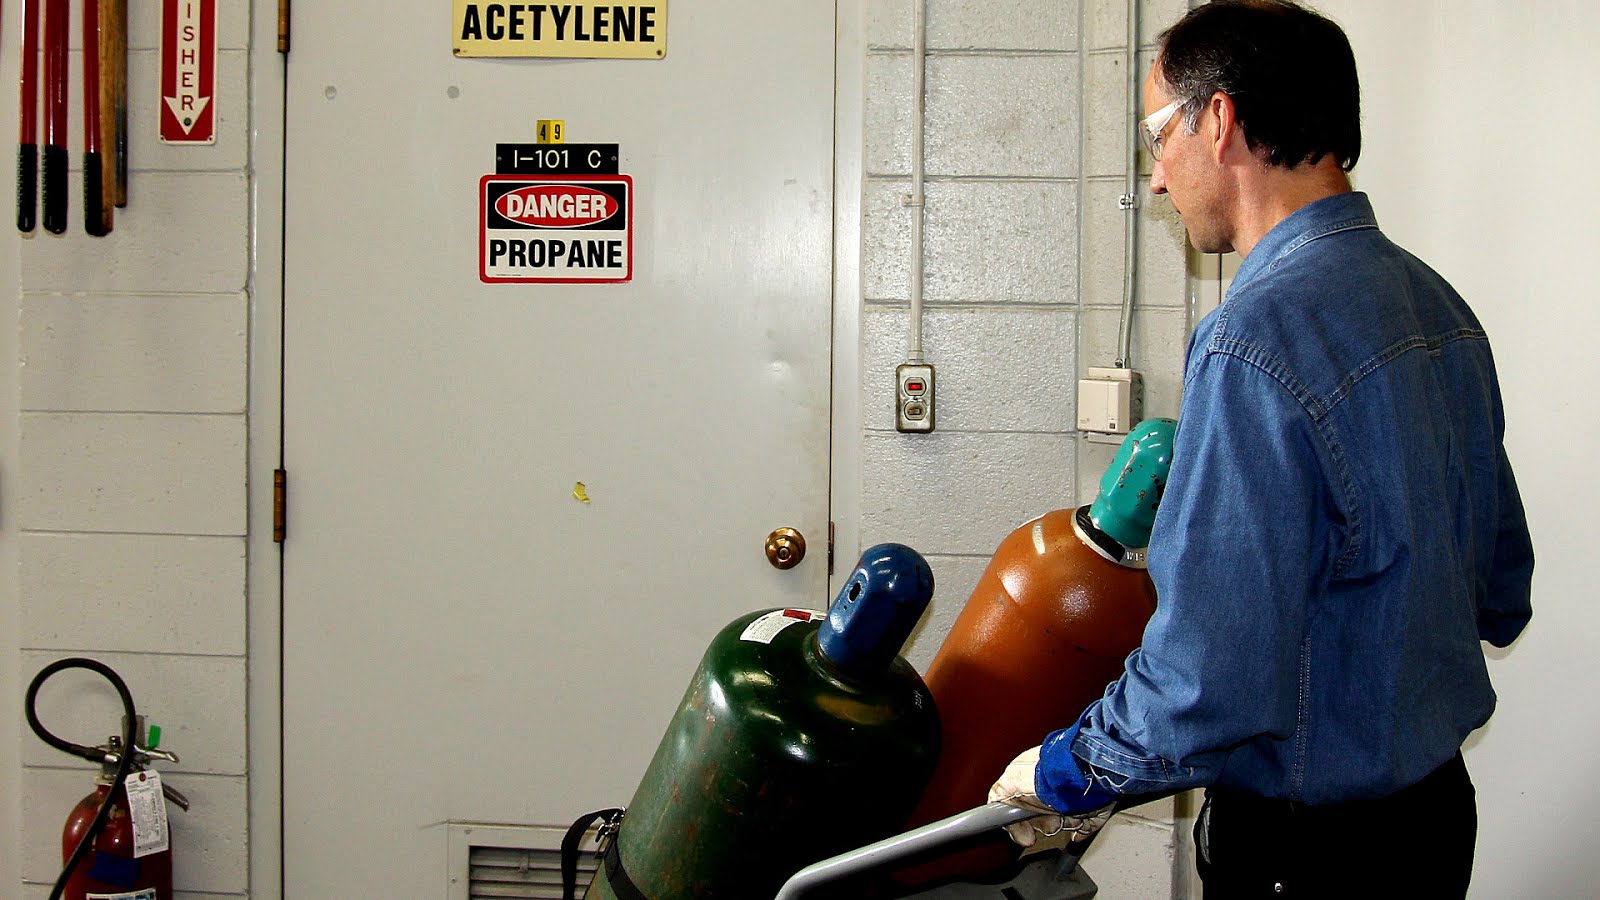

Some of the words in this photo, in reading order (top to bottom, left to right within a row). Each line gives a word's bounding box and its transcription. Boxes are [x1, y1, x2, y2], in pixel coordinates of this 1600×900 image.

[461, 4, 656, 43] ACETYLENE
[587, 150, 601, 169] C
[506, 194, 607, 219] DANGER
[489, 239, 622, 268] PROPANE
